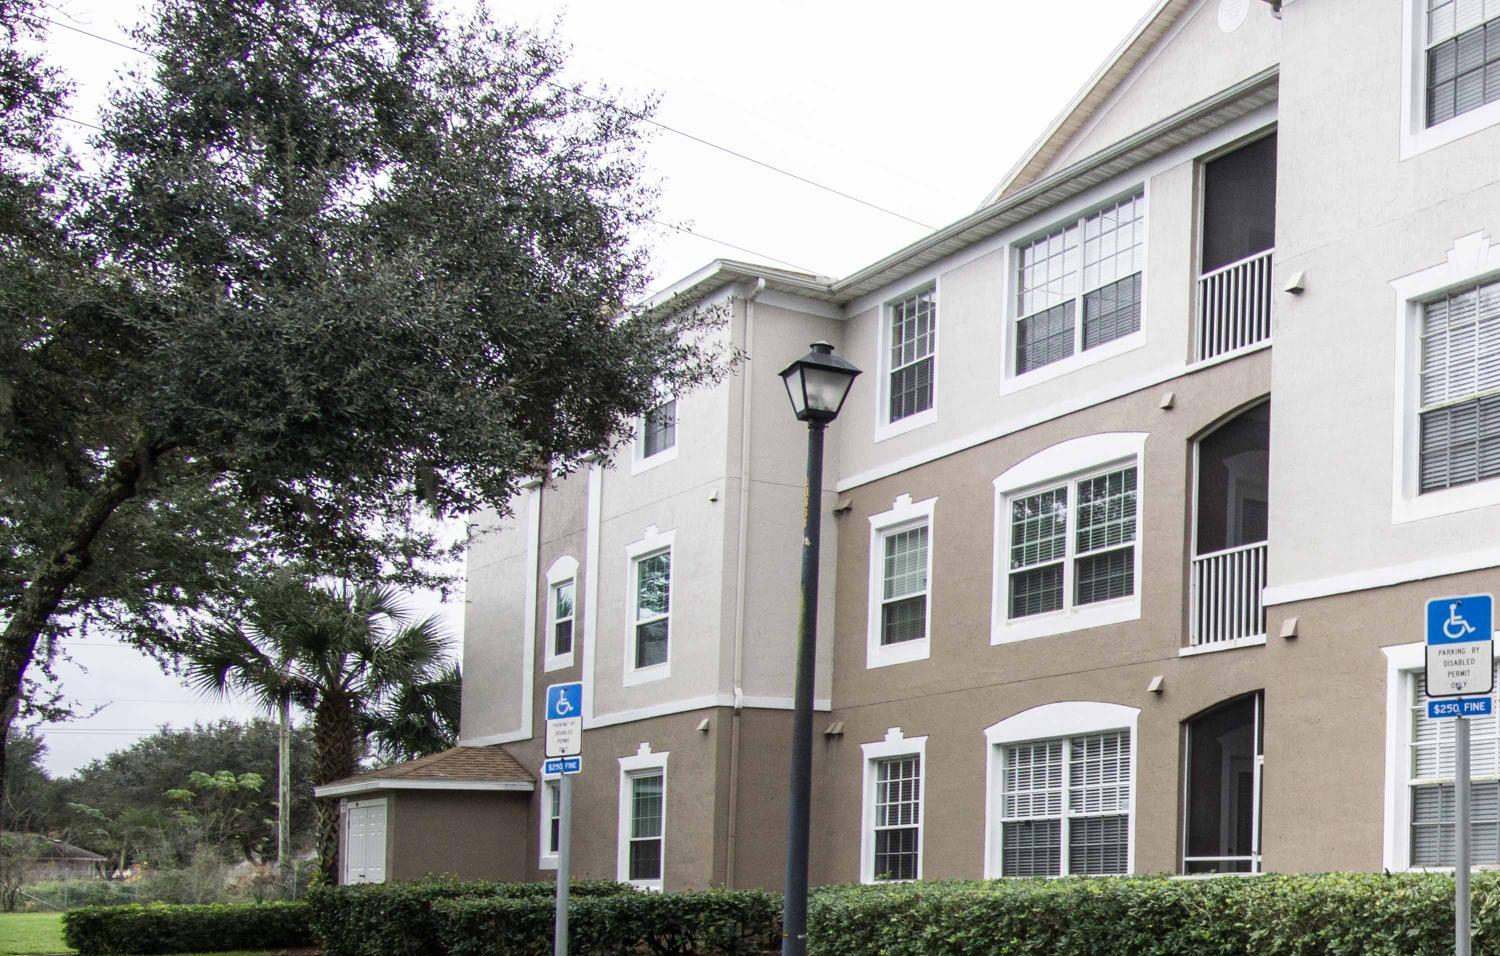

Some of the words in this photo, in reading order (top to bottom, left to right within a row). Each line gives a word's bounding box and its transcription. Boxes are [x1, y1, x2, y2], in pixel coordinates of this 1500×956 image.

[1438, 647, 1466, 657] PARKING
[1471, 646, 1480, 654] BY
[1443, 658, 1475, 668] DISABLED
[1447, 669, 1471, 678] PERMIT
[1450, 681, 1468, 690] ONLY
[1464, 701, 1486, 713] FINE
[564, 761, 577, 770] FINE
